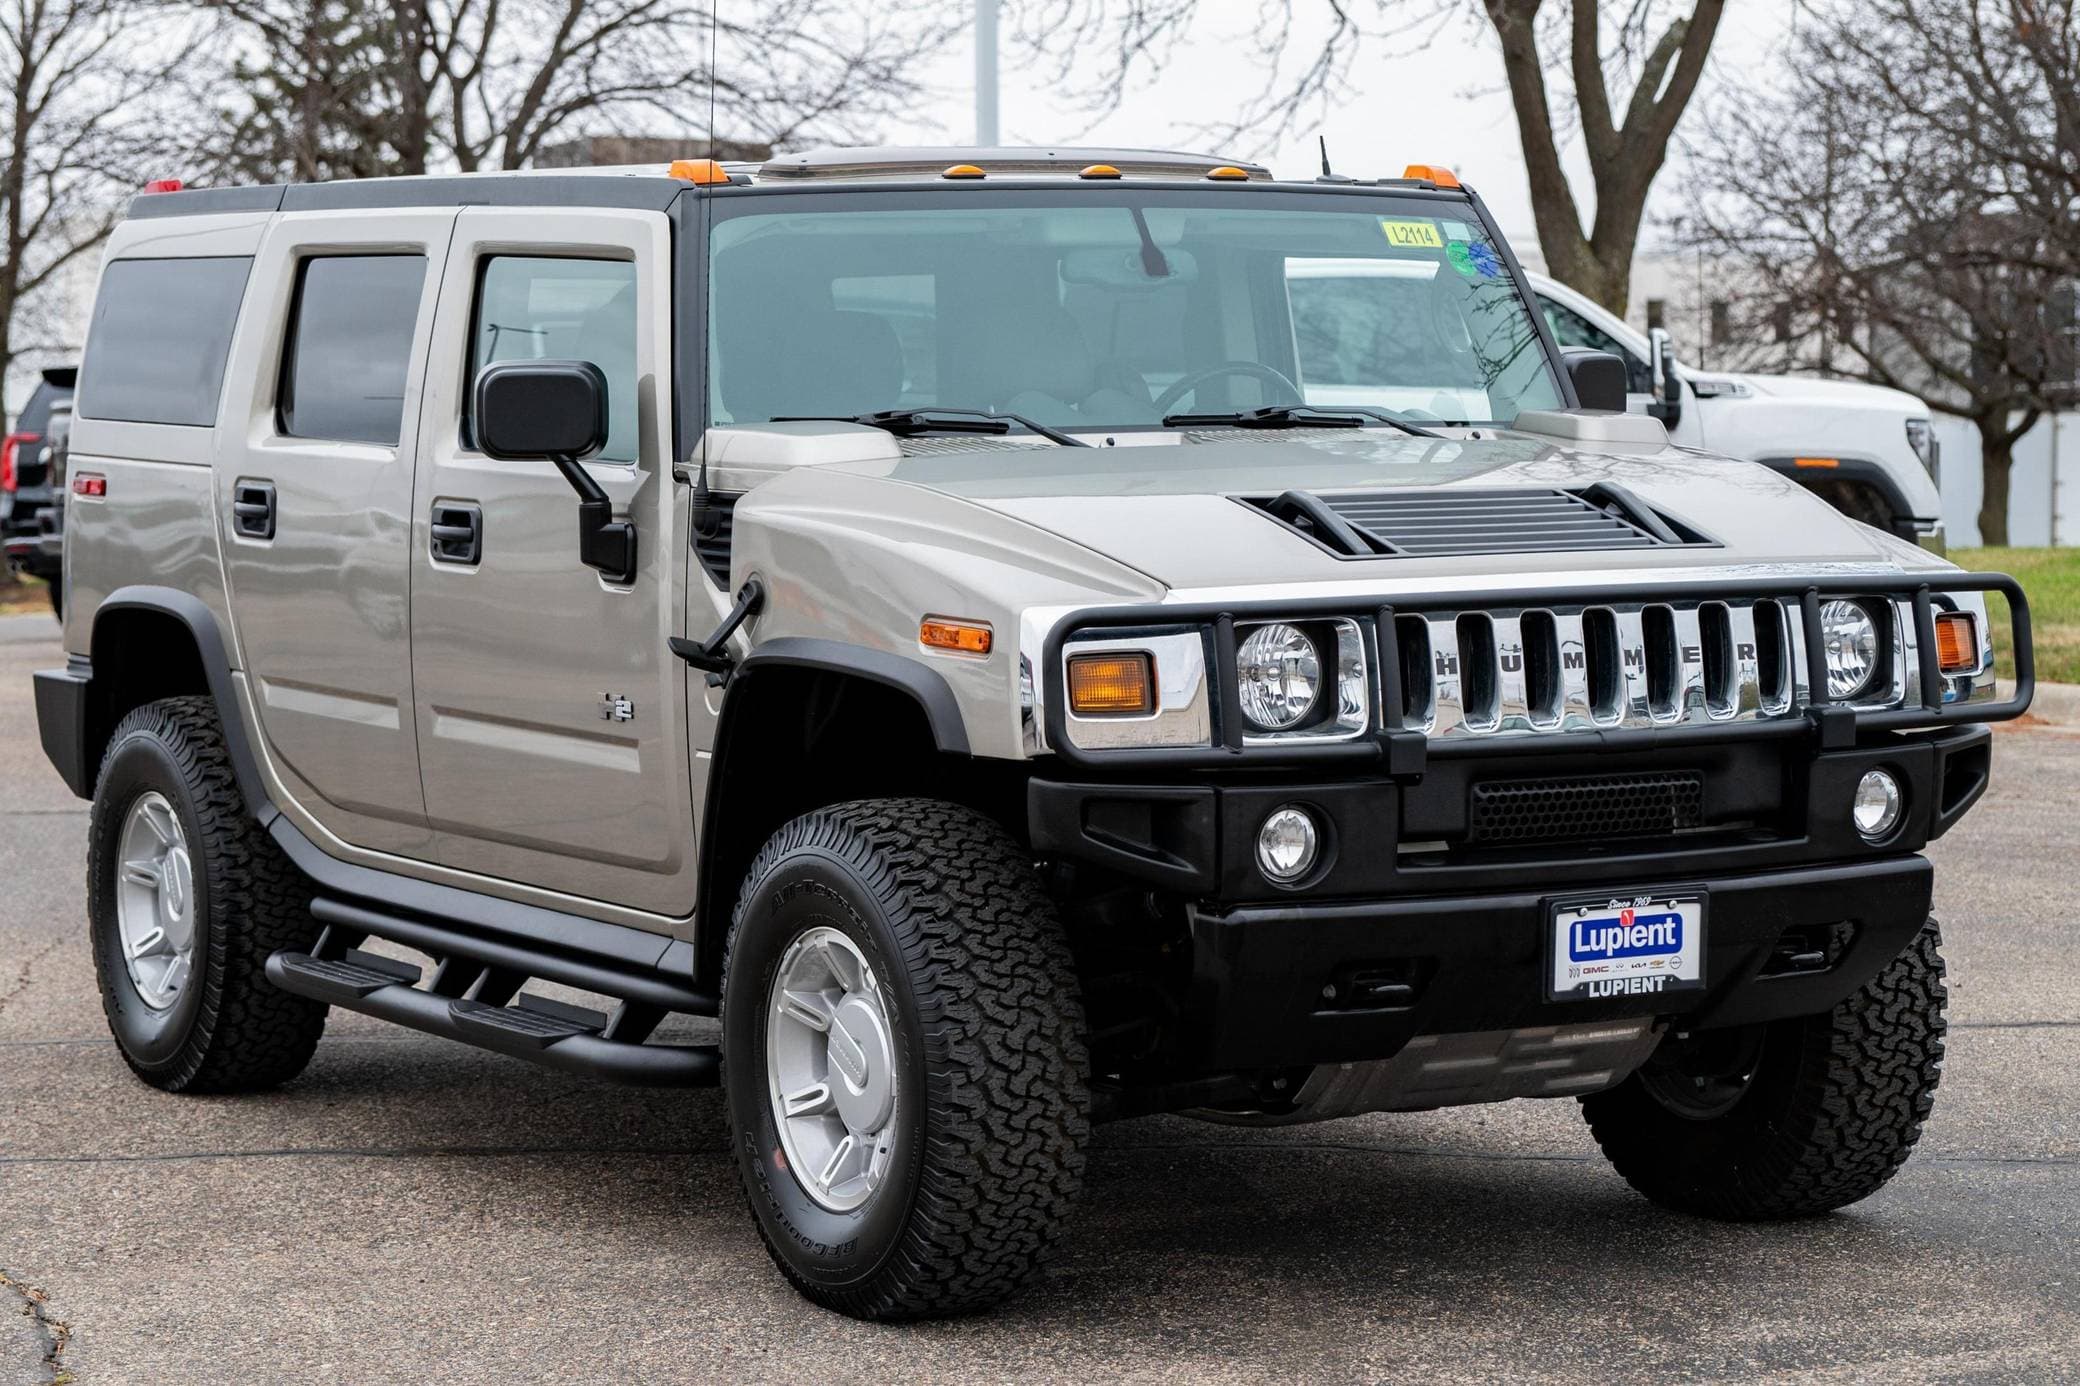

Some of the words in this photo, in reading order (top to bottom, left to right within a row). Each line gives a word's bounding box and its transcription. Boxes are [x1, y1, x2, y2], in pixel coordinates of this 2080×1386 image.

[1392, 226, 1434, 245] L2114
[1436, 643, 1756, 675] HUMMER
[1607, 899, 1631, 910] Since
[1575, 917, 1677, 956] Lupient
[1582, 965, 1609, 974] GMC
[1588, 975, 1666, 998] LUPIENT
